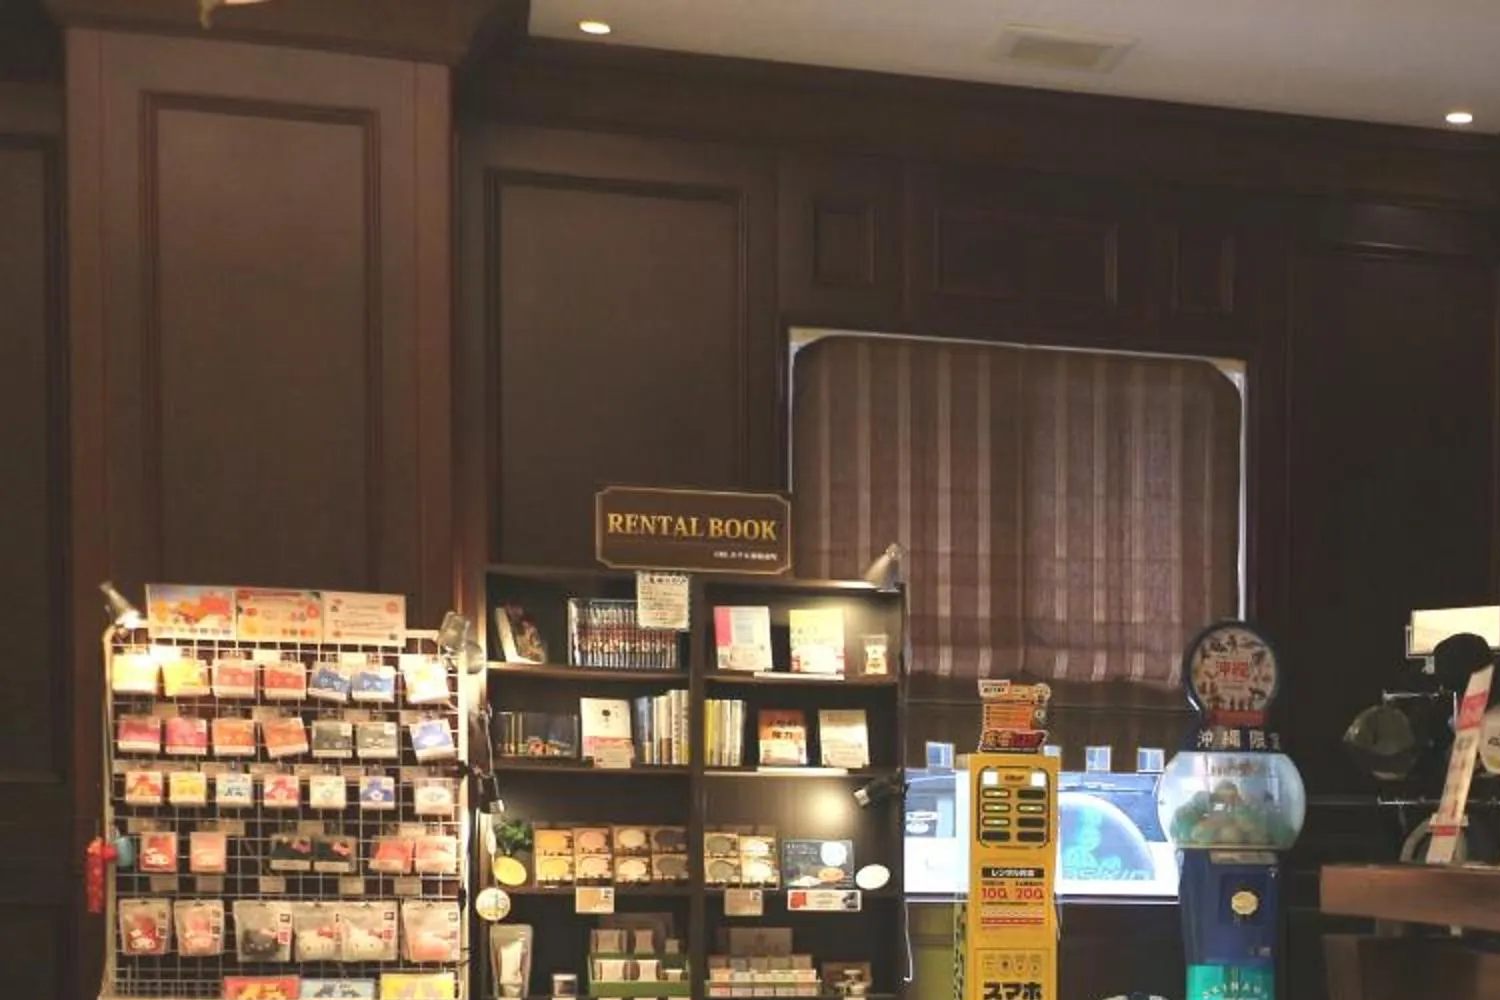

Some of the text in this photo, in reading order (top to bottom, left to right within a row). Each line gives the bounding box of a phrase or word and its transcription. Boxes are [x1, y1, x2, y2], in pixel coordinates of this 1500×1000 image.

[607, 512, 777, 541] RENTAL BOOK
[983, 982, 1042, 1000] スマホ
